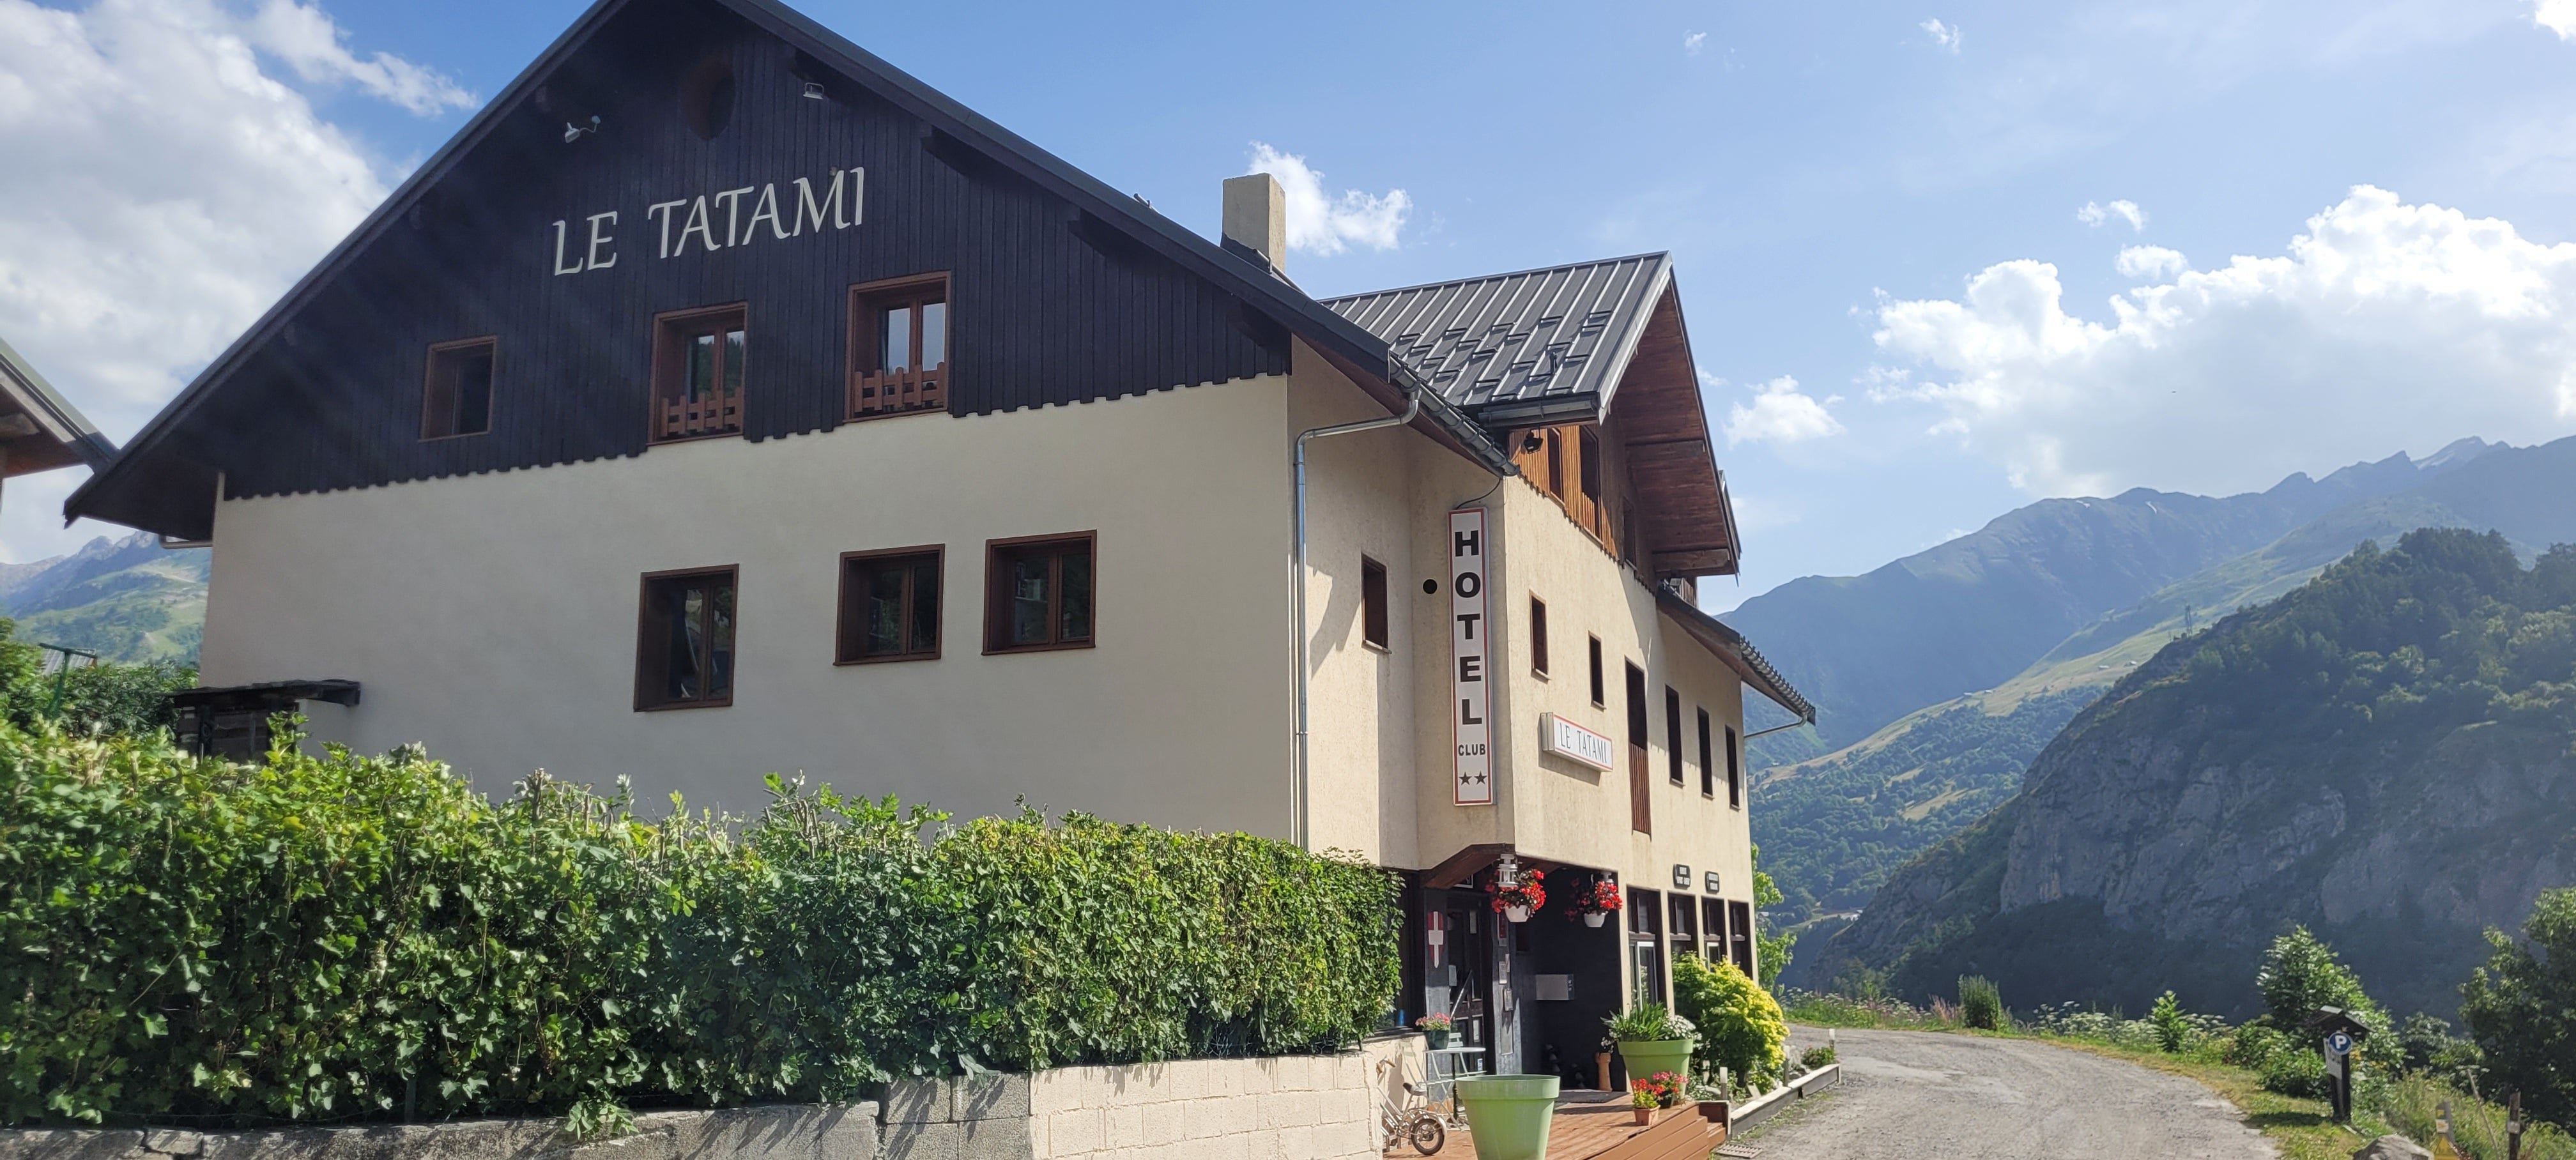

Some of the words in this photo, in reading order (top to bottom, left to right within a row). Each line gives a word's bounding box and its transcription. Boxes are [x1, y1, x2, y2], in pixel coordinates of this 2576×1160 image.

[553, 211, 618, 276] LE
[648, 167, 864, 259] TATAMI
[1455, 530, 1482, 724] HOTEL
[1458, 744, 1486, 756] CLUB
[1560, 722, 1570, 749] LE
[1577, 730, 1607, 763] TATAMI
[2335, 1035, 2347, 1049] P
